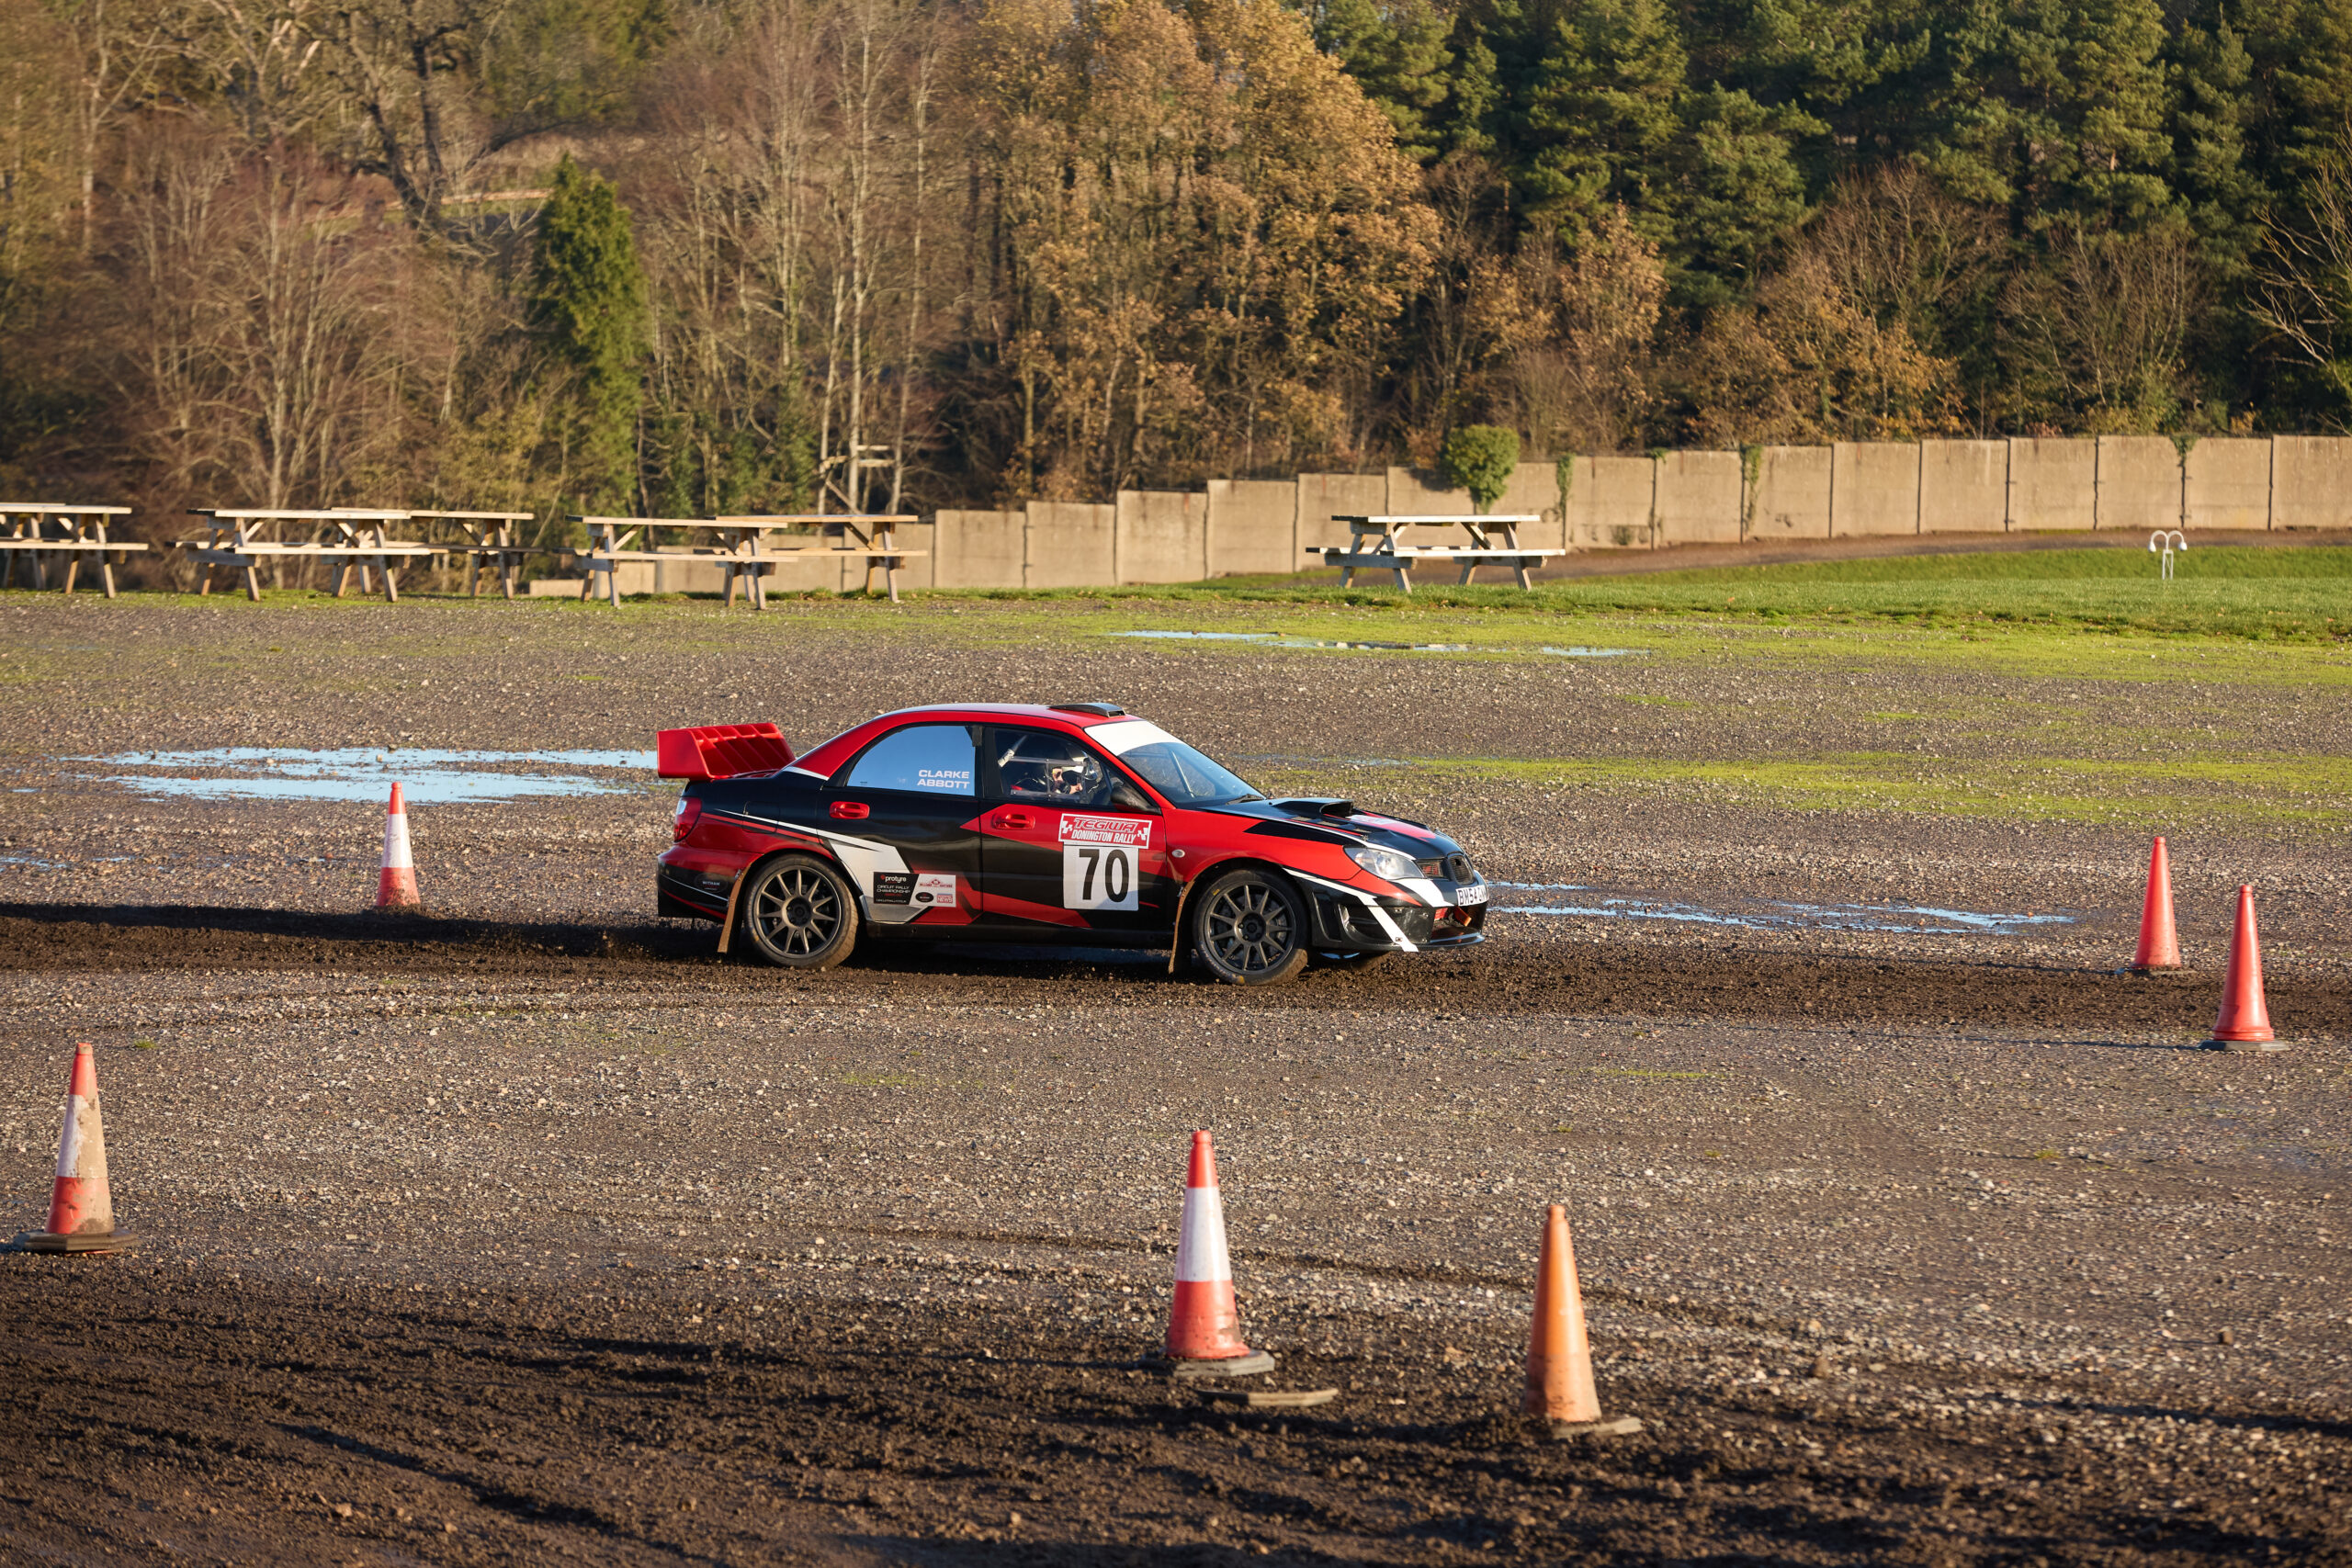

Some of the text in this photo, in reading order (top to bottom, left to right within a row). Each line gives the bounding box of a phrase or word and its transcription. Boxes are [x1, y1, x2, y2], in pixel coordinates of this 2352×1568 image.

[919, 770, 970, 779] CLARKE
[917, 779, 970, 789] ABBOTT
[1071, 829, 1136, 844] DONINGTON RALLY
[1079, 849, 1129, 903] 70
